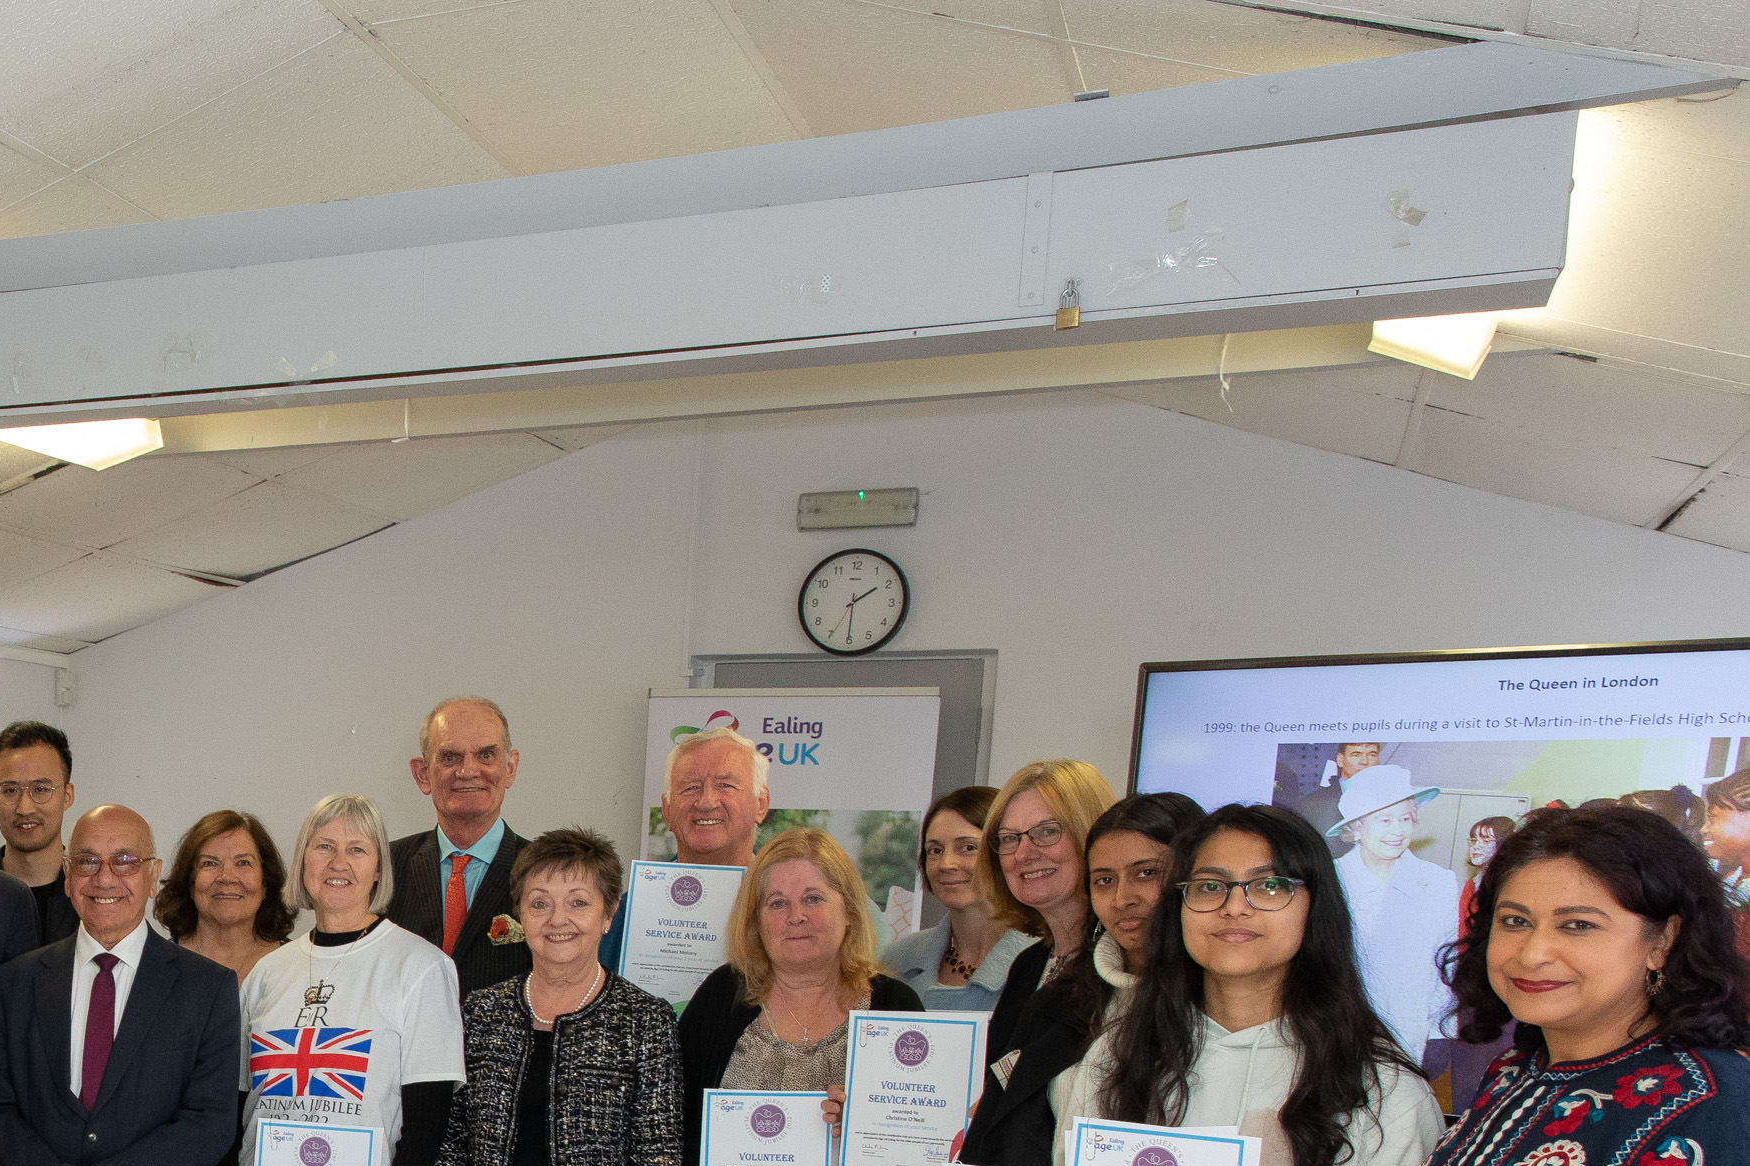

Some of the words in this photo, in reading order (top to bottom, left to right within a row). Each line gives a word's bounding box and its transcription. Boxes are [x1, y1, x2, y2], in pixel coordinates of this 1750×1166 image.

[834, 567, 843, 575] 11
[852, 561, 862, 570] 12
[874, 567, 879, 575] 1
[818, 580, 828, 588] 10
[885, 580, 892, 589] 2
[815, 617, 821, 625] 8
[827, 630, 834, 638] 7
[846, 636, 852, 645] 6
[1498, 680, 1524, 690] The
[1529, 679, 1578, 691] Queen
[1583, 678, 1596, 688] in
[1601, 676, 1659, 688] London
[762, 717, 823, 739] Ealing
[1204, 722, 1237, 733] 1999:
[1241, 722, 1260, 732] the
[1264, 721, 1305, 733] Queen
[1309, 721, 1348, 731] meets
[1352, 719, 1390, 733] pupils
[1395, 719, 1438, 731] during
[1442, 721, 1449, 729] a
[1454, 717, 1481, 729] visit
[1485, 717, 1500, 728] to
[1504, 714, 1673, 728] St-Martin-in-the-Fields
[1678, 713, 1713, 726] High
[778, 743, 820, 765] UK
[658, 918, 707, 929] VOLUNTEER
[646, 930, 682, 939] SERVICE
[684, 933, 716, 941] AWARD
[881, 1081, 935, 1093] VOLUNTEER
[868, 1094, 907, 1104] SERVICE
[910, 1097, 946, 1107] AWARD
[254, 1099, 305, 1111] LATINUM
[310, 1099, 362, 1115] JUBILEE
[1132, 1141, 1146, 1153] THE
[1150, 1138, 1183, 1158] QUEEN'S
[739, 1152, 794, 1162] VOLUNTEER
